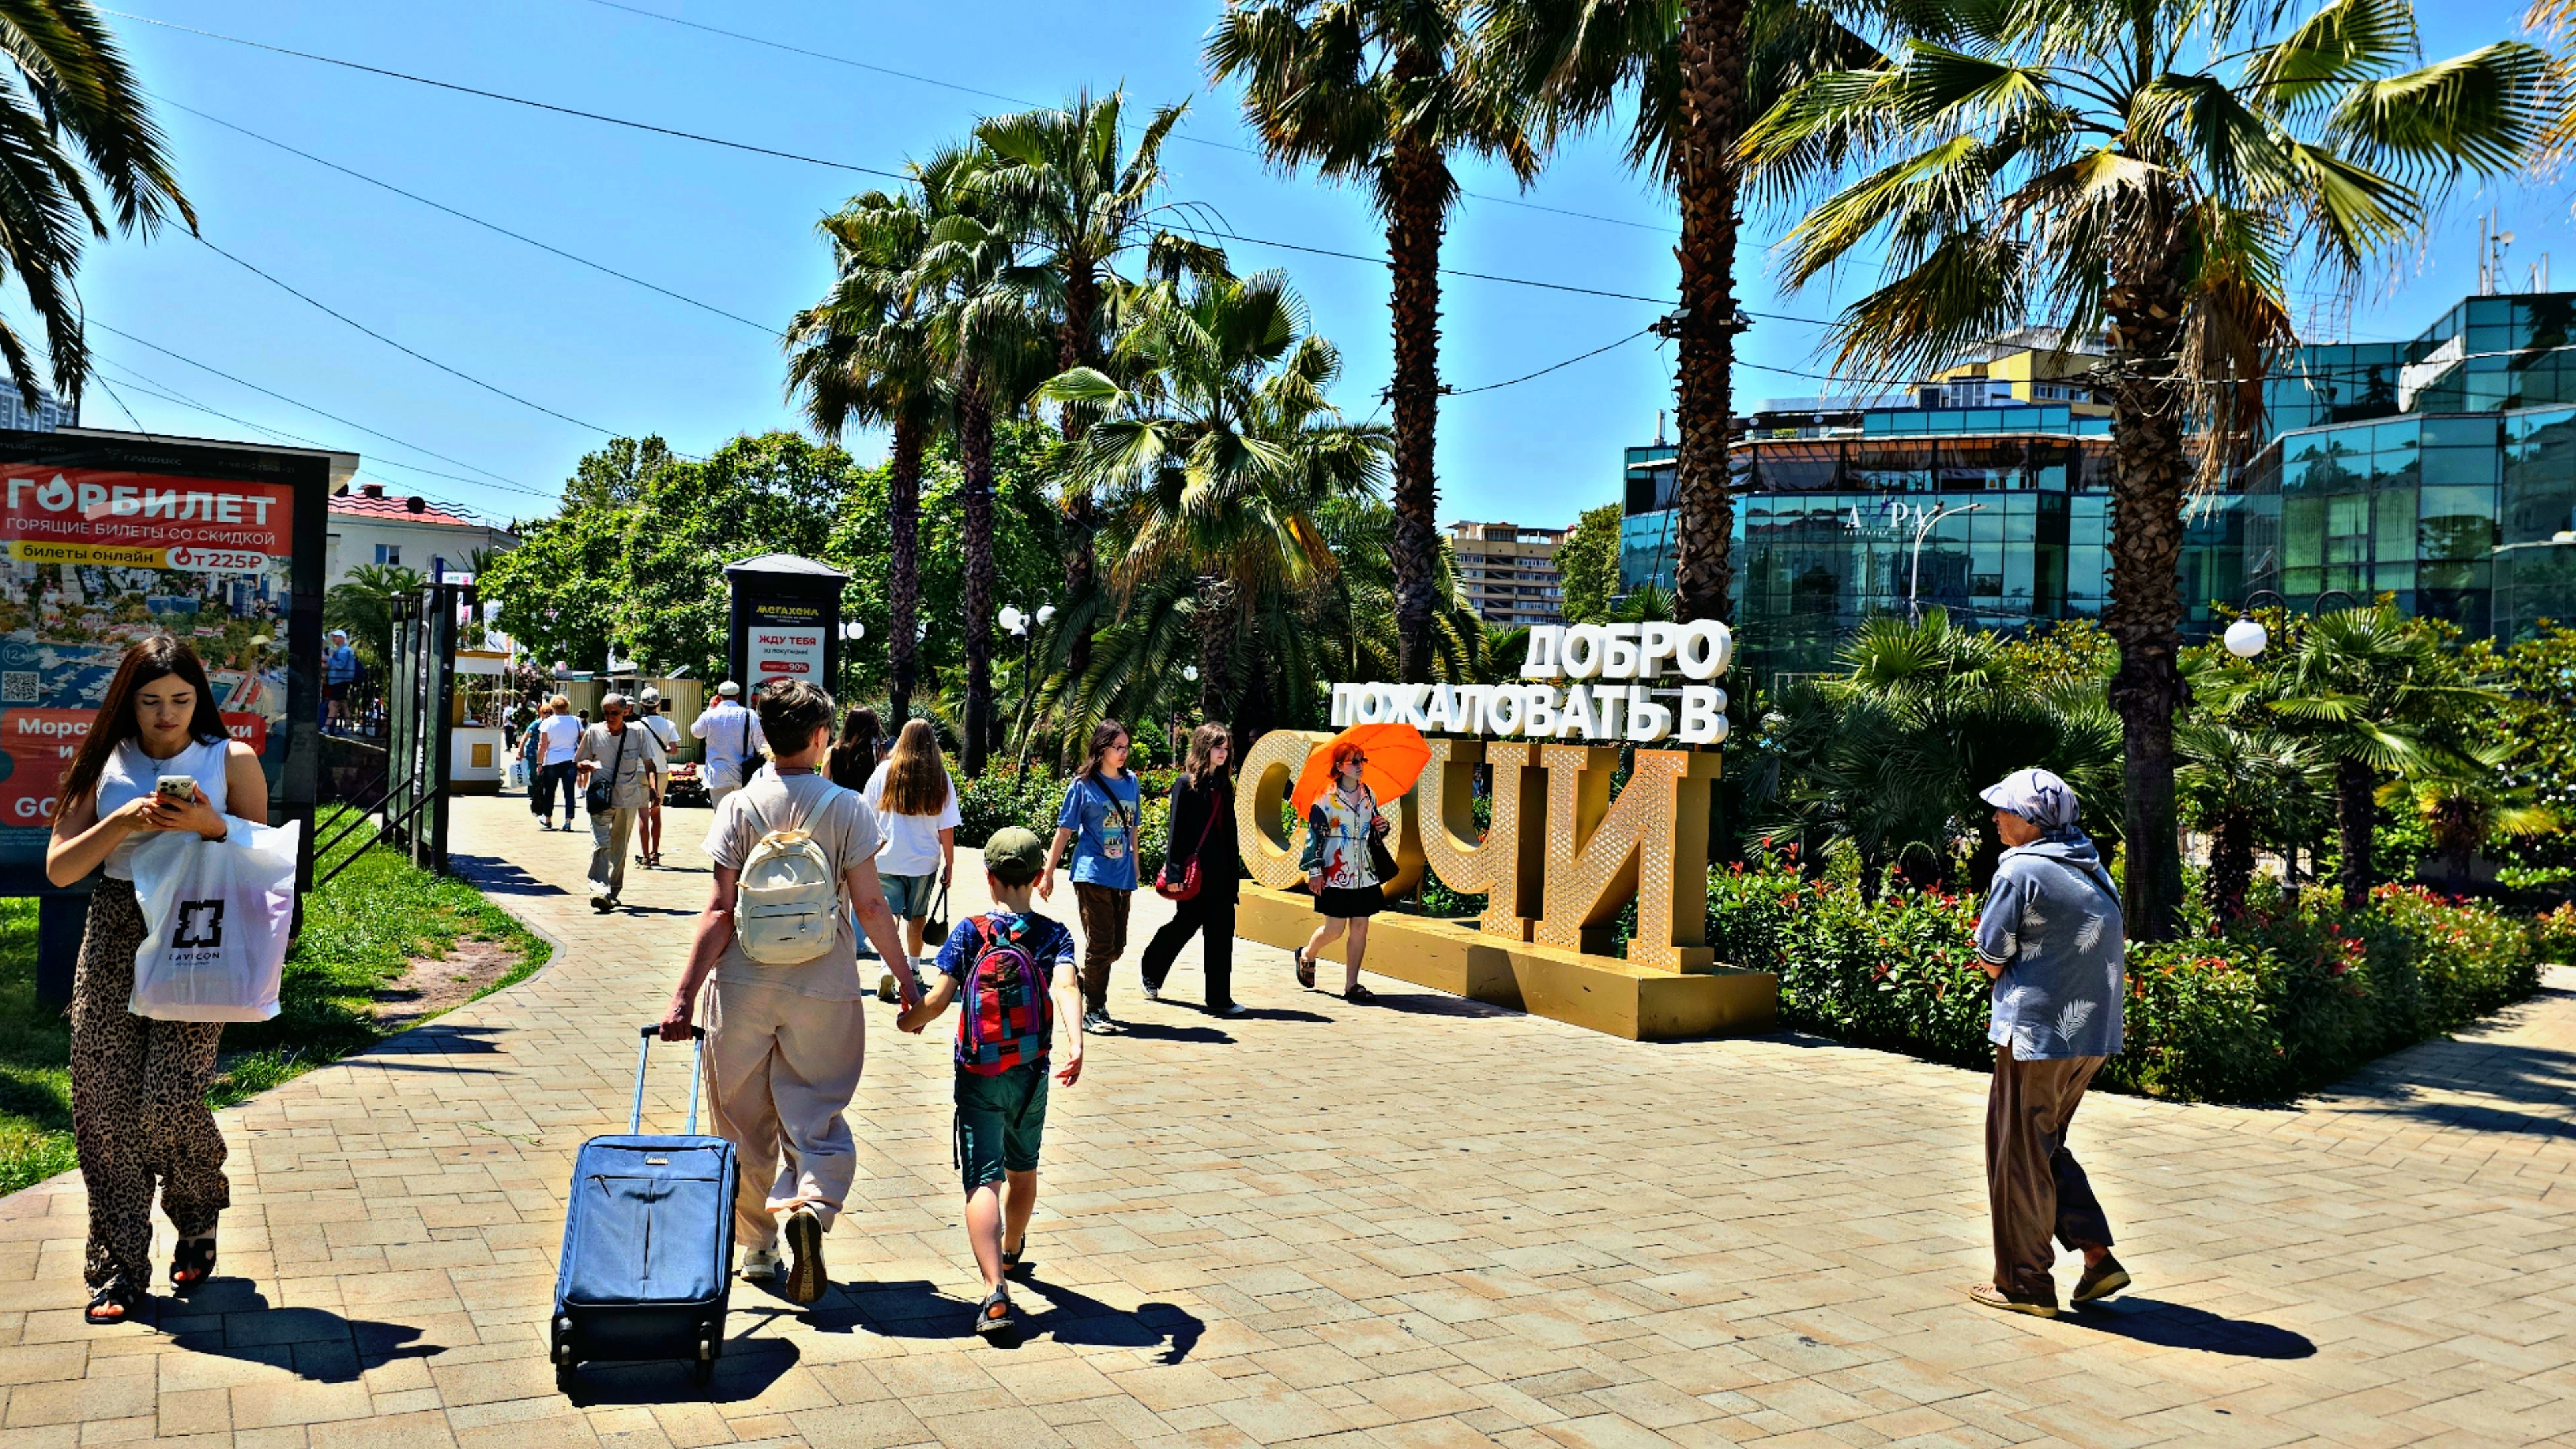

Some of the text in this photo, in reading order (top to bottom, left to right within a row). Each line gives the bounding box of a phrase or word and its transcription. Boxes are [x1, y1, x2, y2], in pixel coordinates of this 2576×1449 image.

[7, 473, 276, 526] ГОРБИЛЕТ
[7, 518, 276, 546] ГОРЯЩИЕ БИЛЕТЫ СО СКИДКОЙ
[23, 544, 154, 564] билеты онлайн
[5, 649, 25, 660] 12+
[759, 635, 817, 646] ЖДУ ТЕБЯ
[1520, 618, 1731, 679] ДОБРО
[1331, 683, 1729, 744] ПОЖАЛОВАТЬ В
